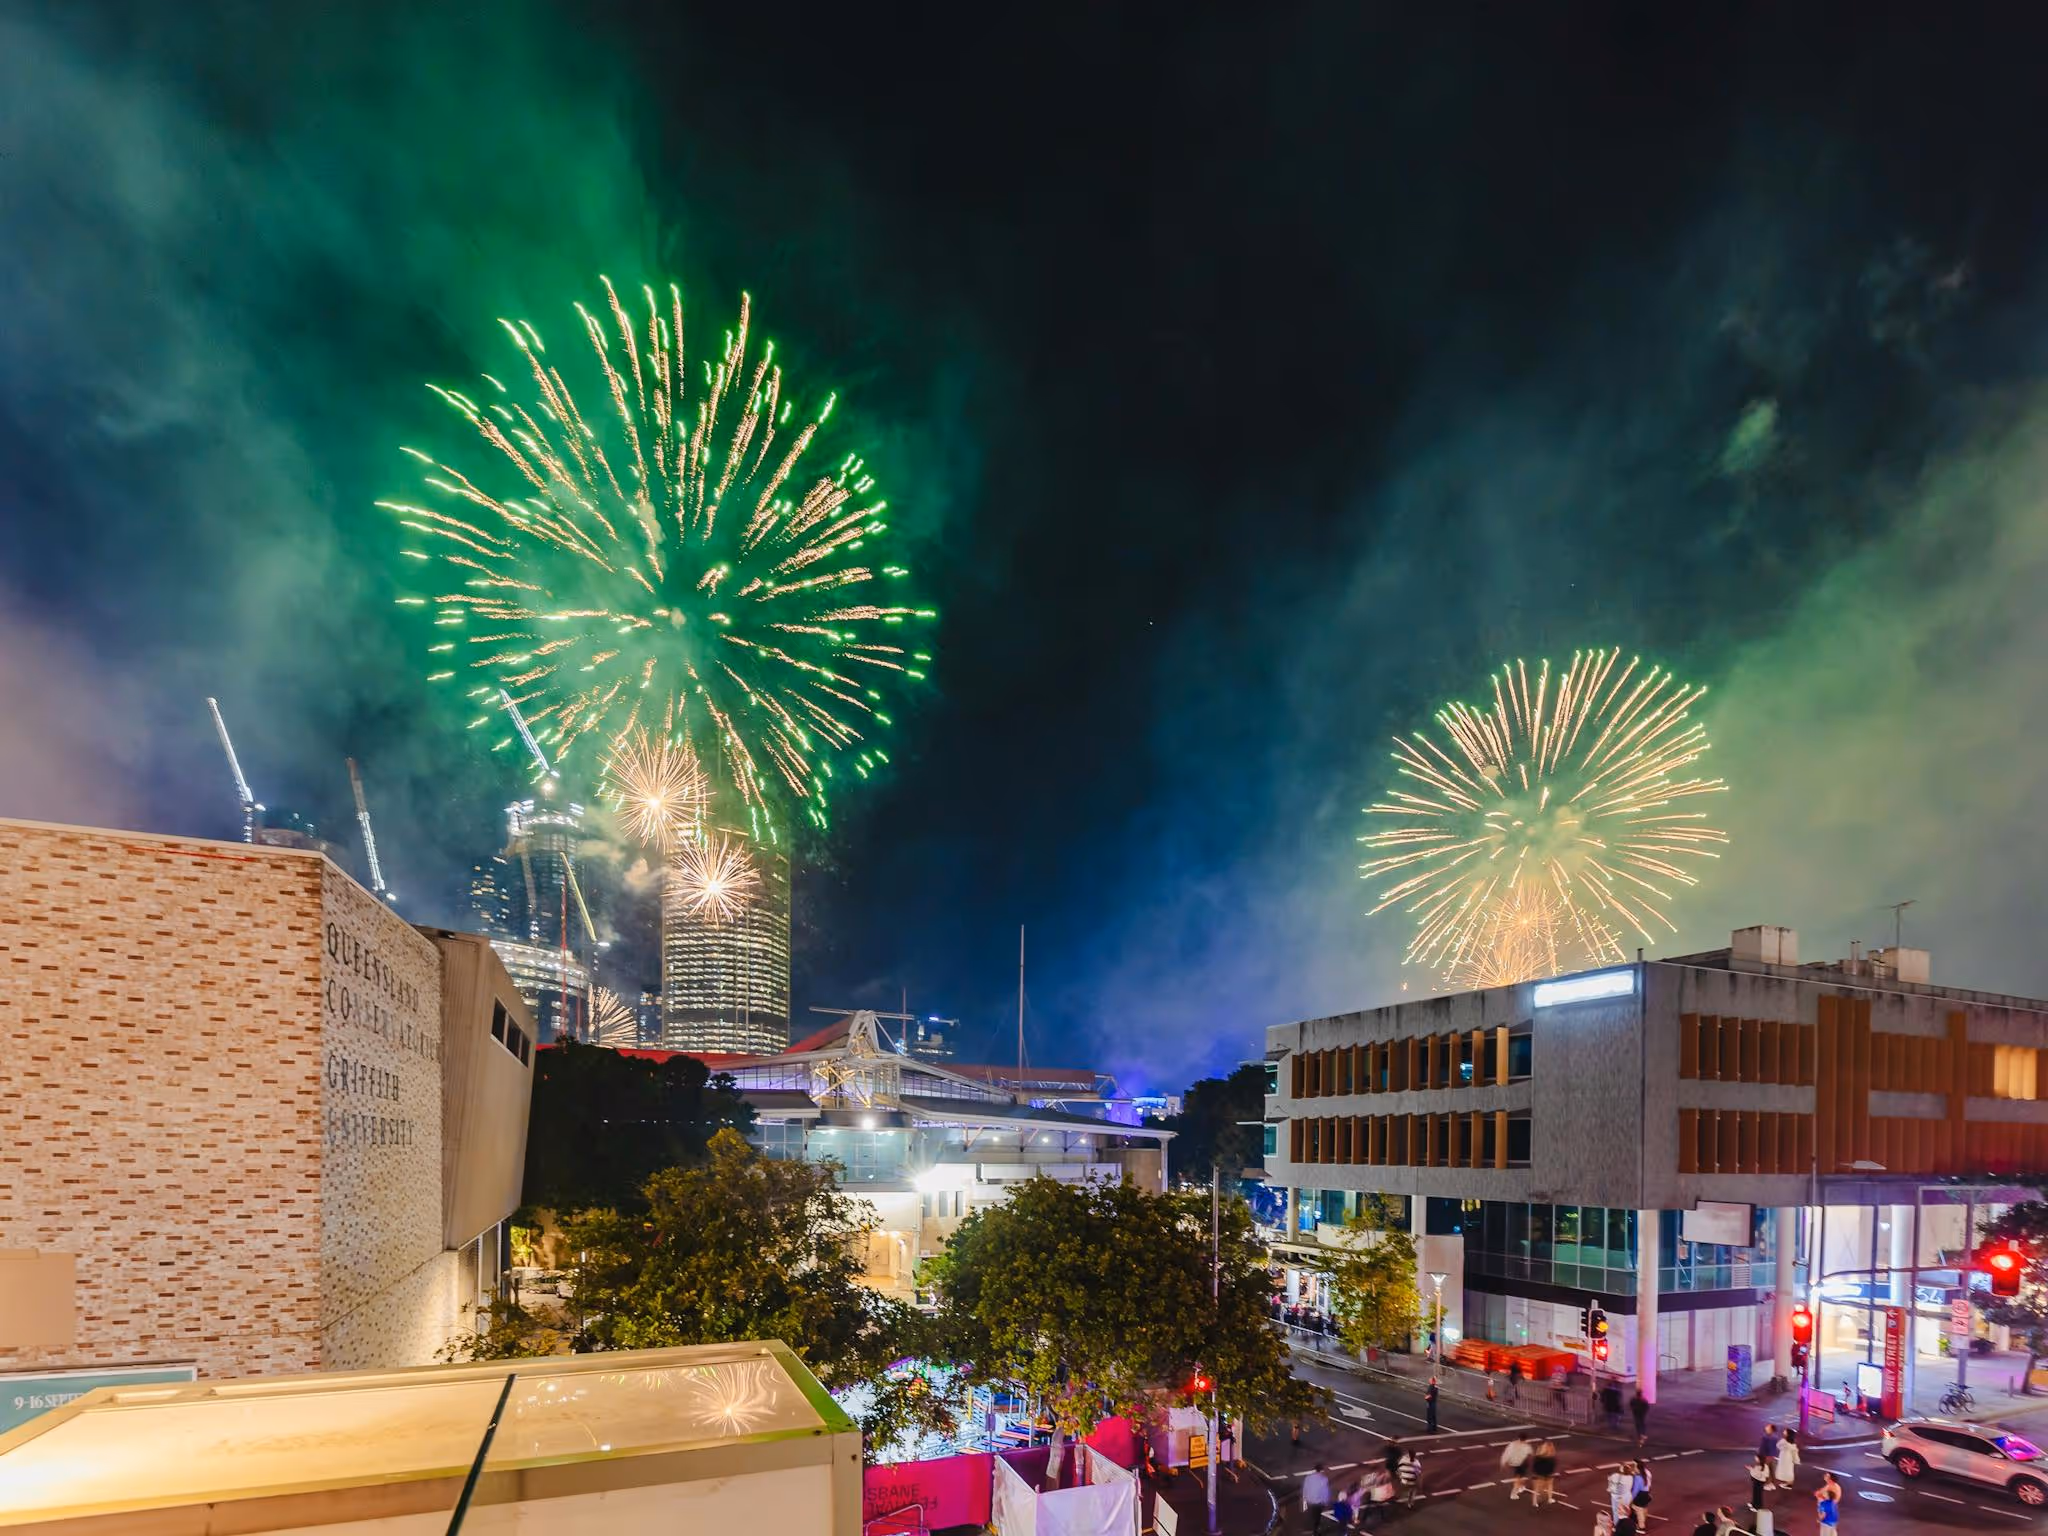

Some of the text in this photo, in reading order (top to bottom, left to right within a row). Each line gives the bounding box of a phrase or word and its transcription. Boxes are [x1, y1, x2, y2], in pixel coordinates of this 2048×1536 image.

[327, 922, 419, 1013] QUEENSLAND
[327, 1053, 400, 1101] GRIFFITH
[327, 1106, 414, 1146] UNIVERSITY
[1886, 1332, 1898, 1367] STREET
[14, 1394, 43, 1410] 9-16
